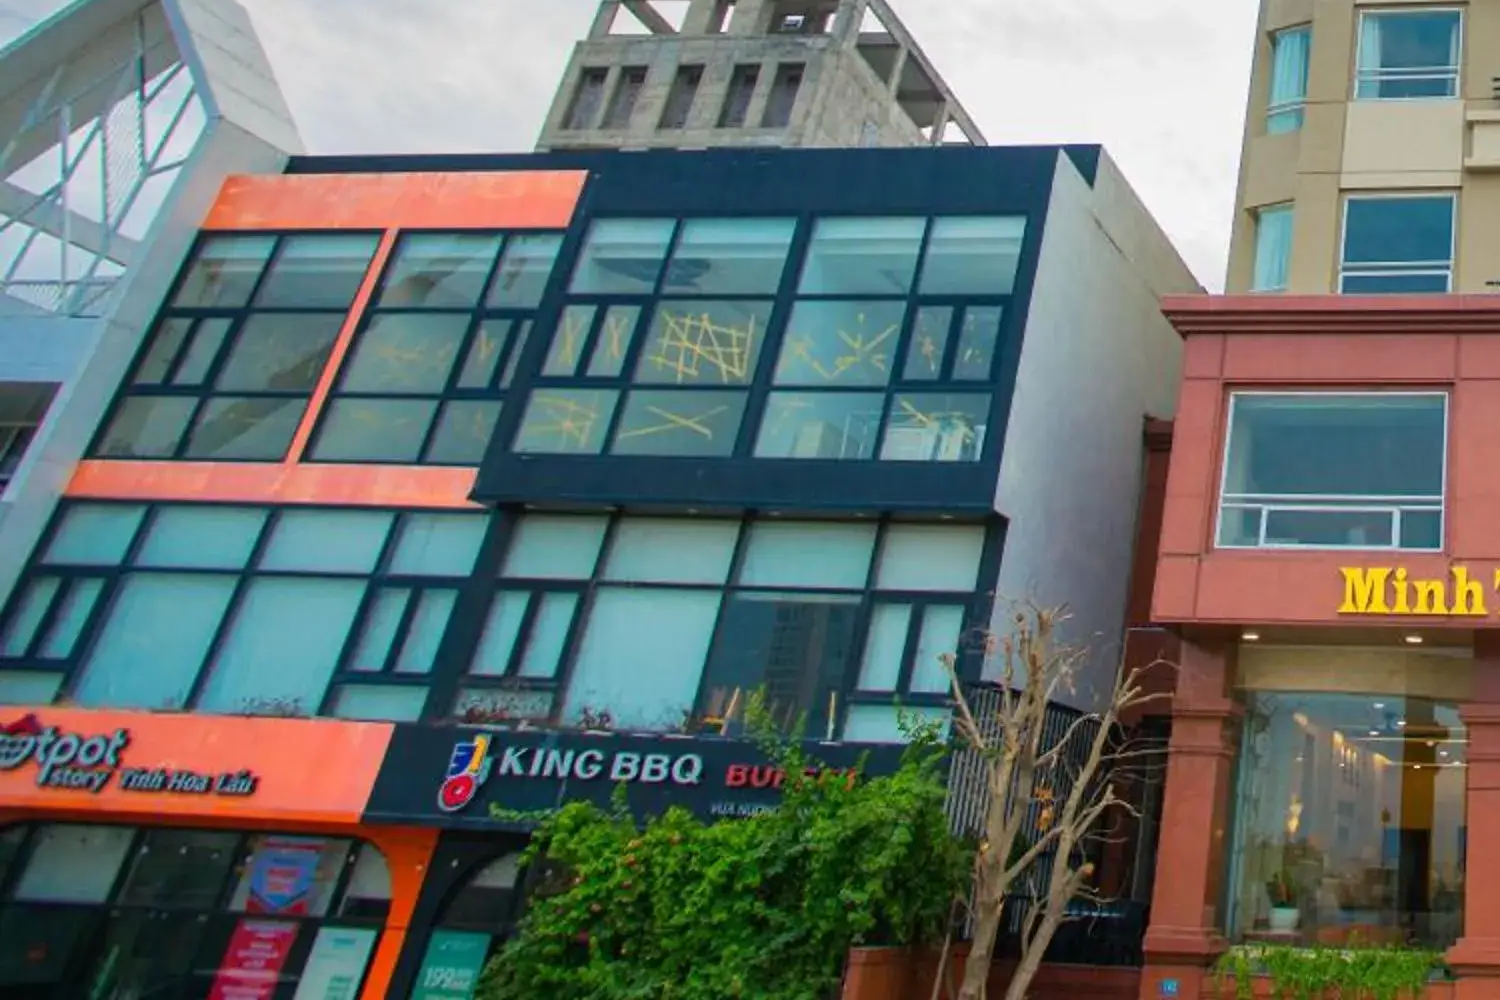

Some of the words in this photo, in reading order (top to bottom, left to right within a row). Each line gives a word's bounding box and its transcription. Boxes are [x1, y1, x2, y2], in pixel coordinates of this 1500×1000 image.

[1337, 566, 1488, 615] Minh
[50, 766, 107, 792] story
[500, 746, 604, 780] KING
[610, 752, 703, 785] BBQ
